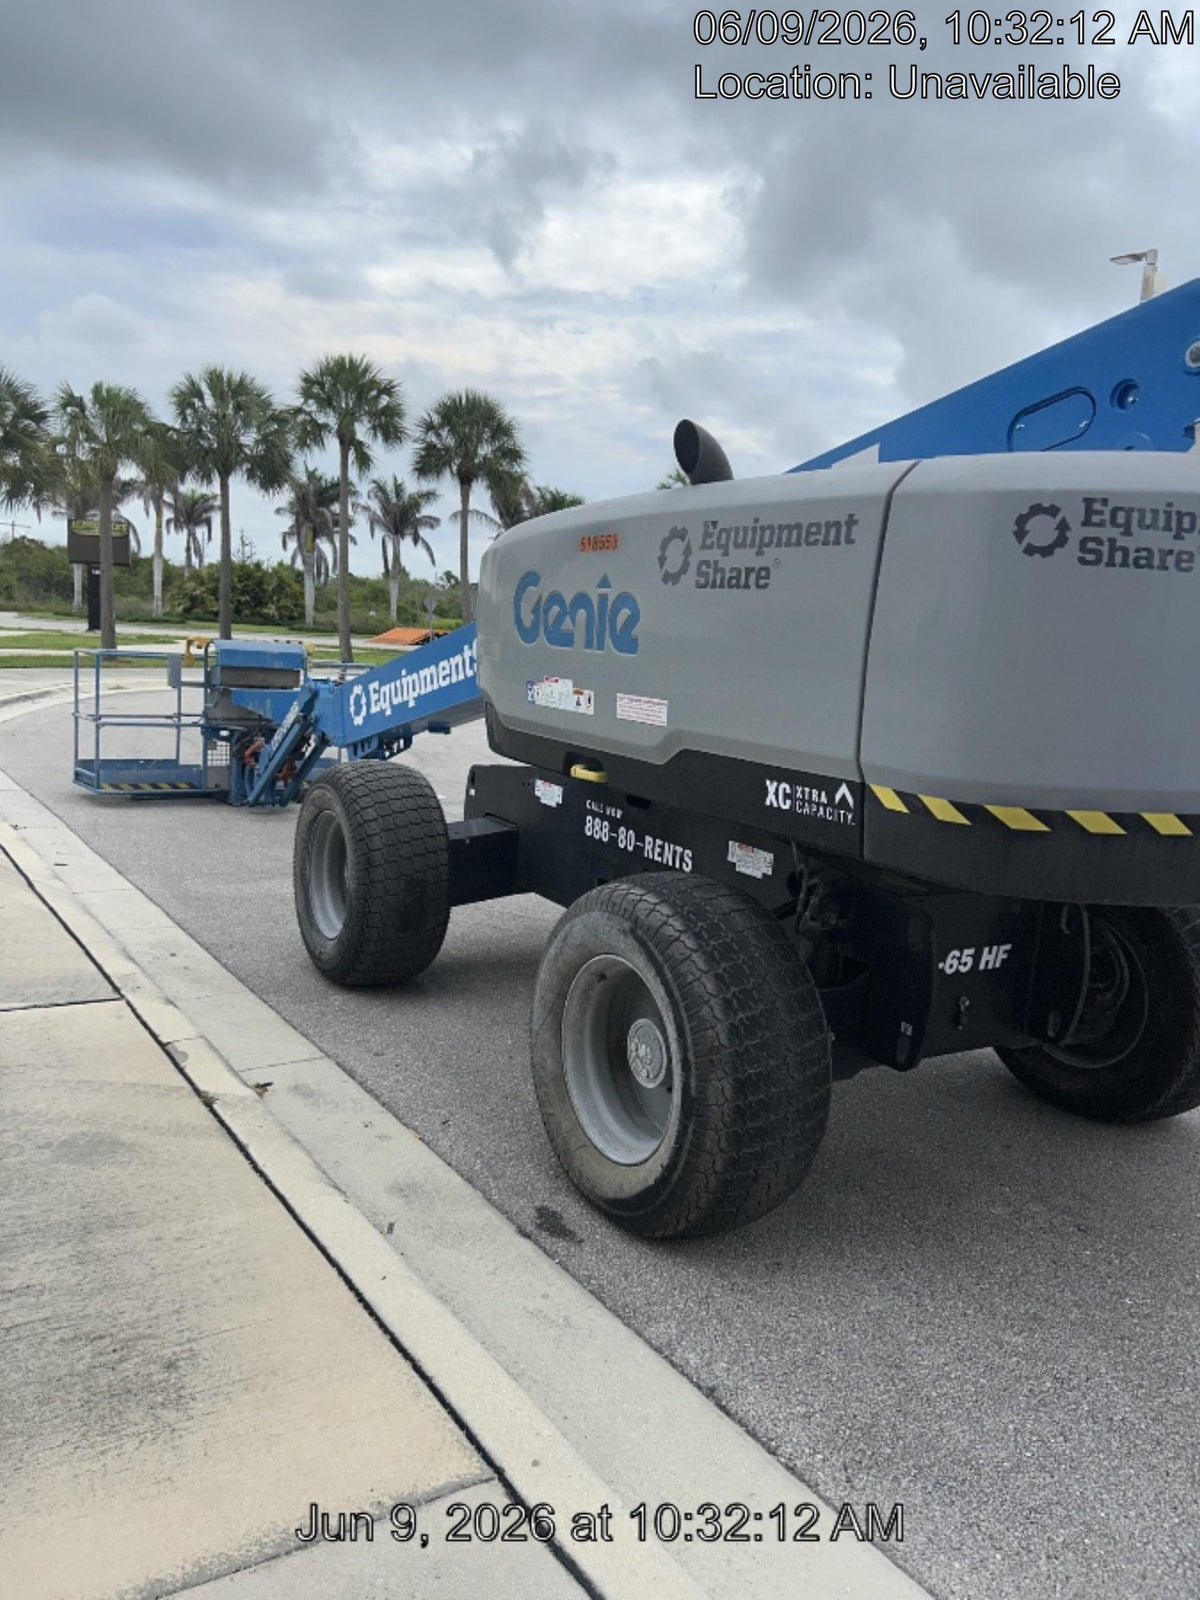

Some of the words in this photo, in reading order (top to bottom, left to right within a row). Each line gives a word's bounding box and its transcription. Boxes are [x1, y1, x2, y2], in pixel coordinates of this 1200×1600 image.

[700, 513, 859, 557] Equipment
[1080, 497, 1200, 540] Equip
[1077, 536, 1196, 573] Share
[513, 570, 641, 656] Genie
[764, 779, 792, 810] XC
[796, 785, 828, 805] XTRA
[585, 815, 693, 874] 888-80-RENTS
[979, 944, 1012, 970] HF
